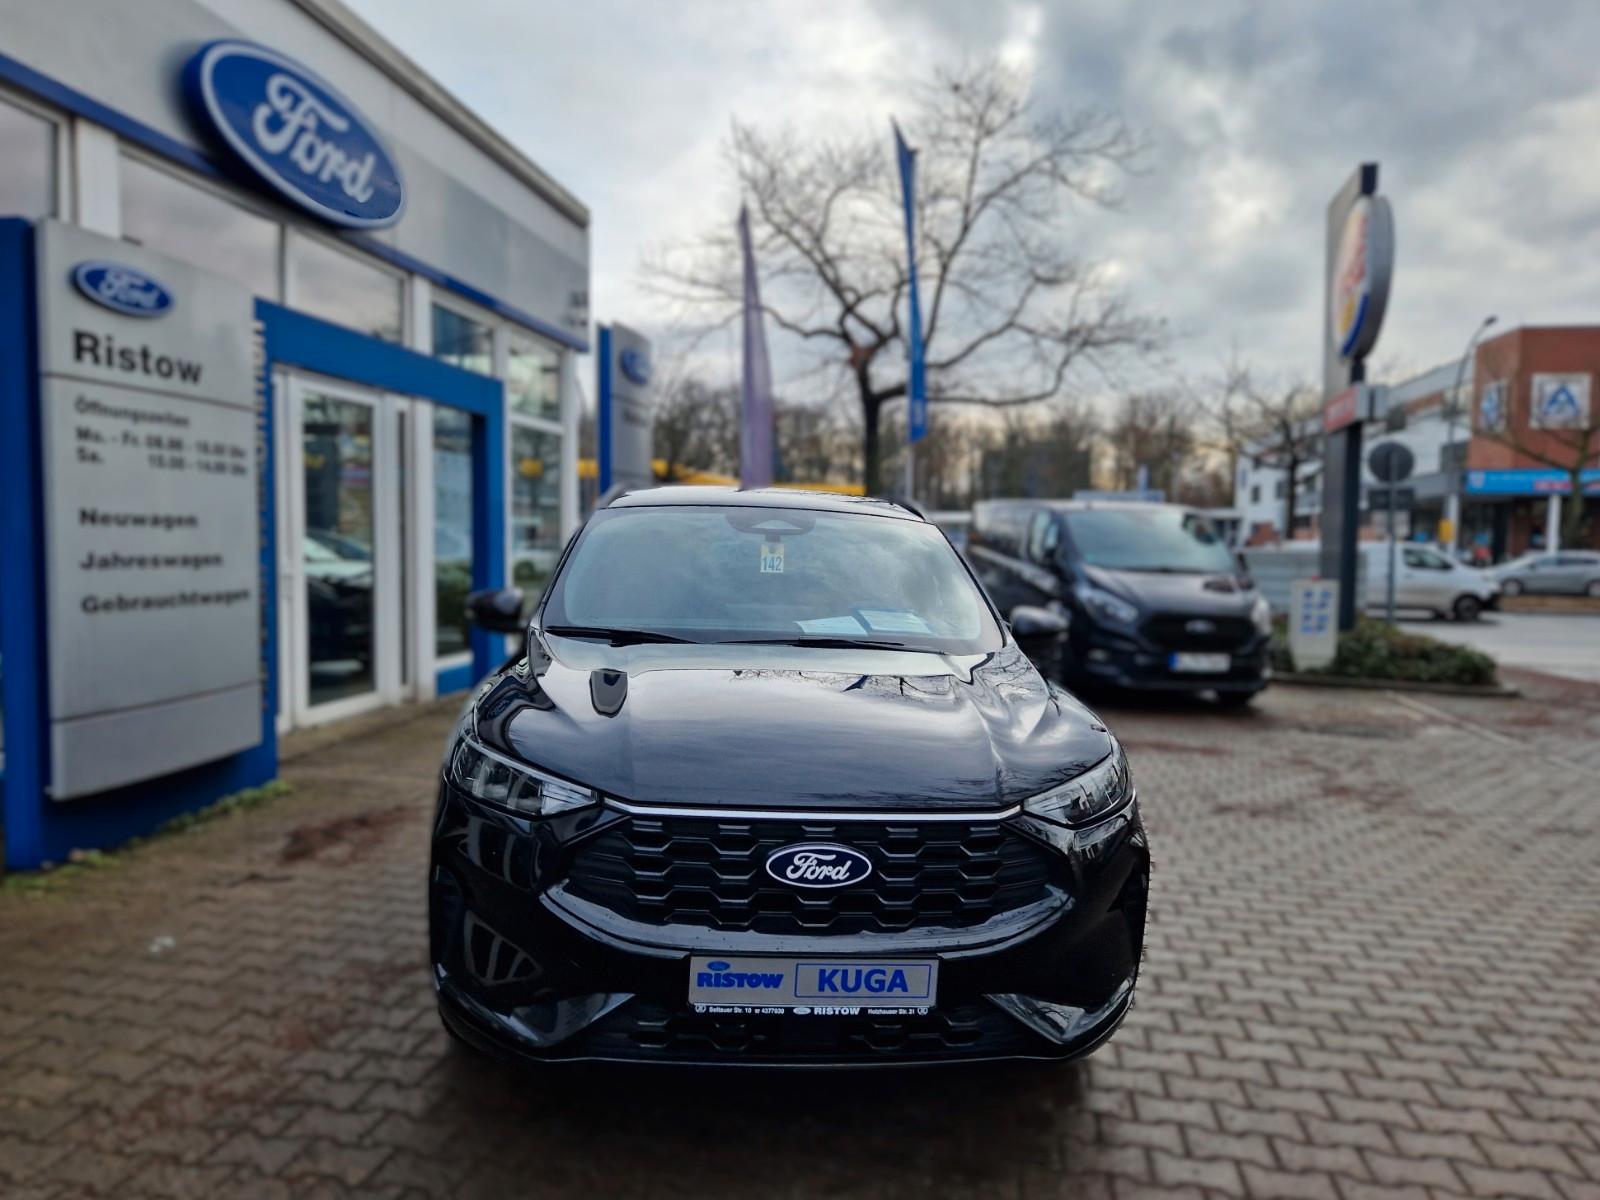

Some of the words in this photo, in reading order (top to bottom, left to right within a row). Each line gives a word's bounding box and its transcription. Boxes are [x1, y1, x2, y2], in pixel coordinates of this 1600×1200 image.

[252, 73, 376, 203] Ford
[73, 329, 202, 384] Ristow
[79, 508, 198, 531] Neuwagen
[80, 553, 222, 571] Jahreswagen
[763, 556, 782, 571] 142
[82, 589, 250, 614] Gebrauchtwagen
[786, 852, 852, 880] Ford
[697, 972, 784, 988] RISTOW
[818, 969, 908, 992] KUGA
[814, 1007, 860, 1015] RISTOW
